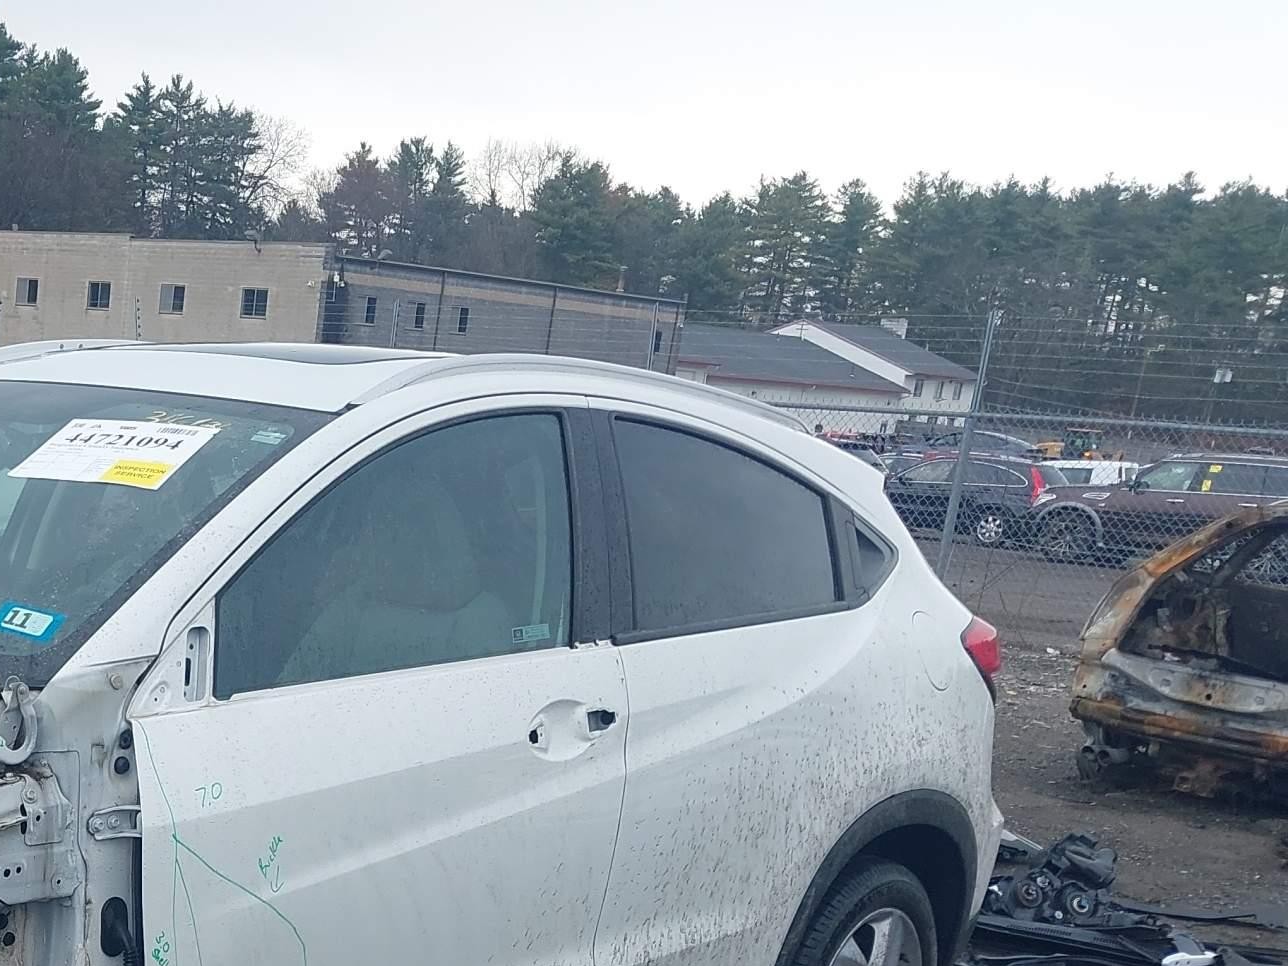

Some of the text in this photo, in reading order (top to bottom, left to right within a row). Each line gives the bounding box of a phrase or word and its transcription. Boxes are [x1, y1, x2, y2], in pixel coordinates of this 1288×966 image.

[64, 431, 184, 452] 44721094
[113, 469, 155, 480] SERVICE
[114, 464, 167, 475] INSPECTION
[3, 609, 33, 629] 11
